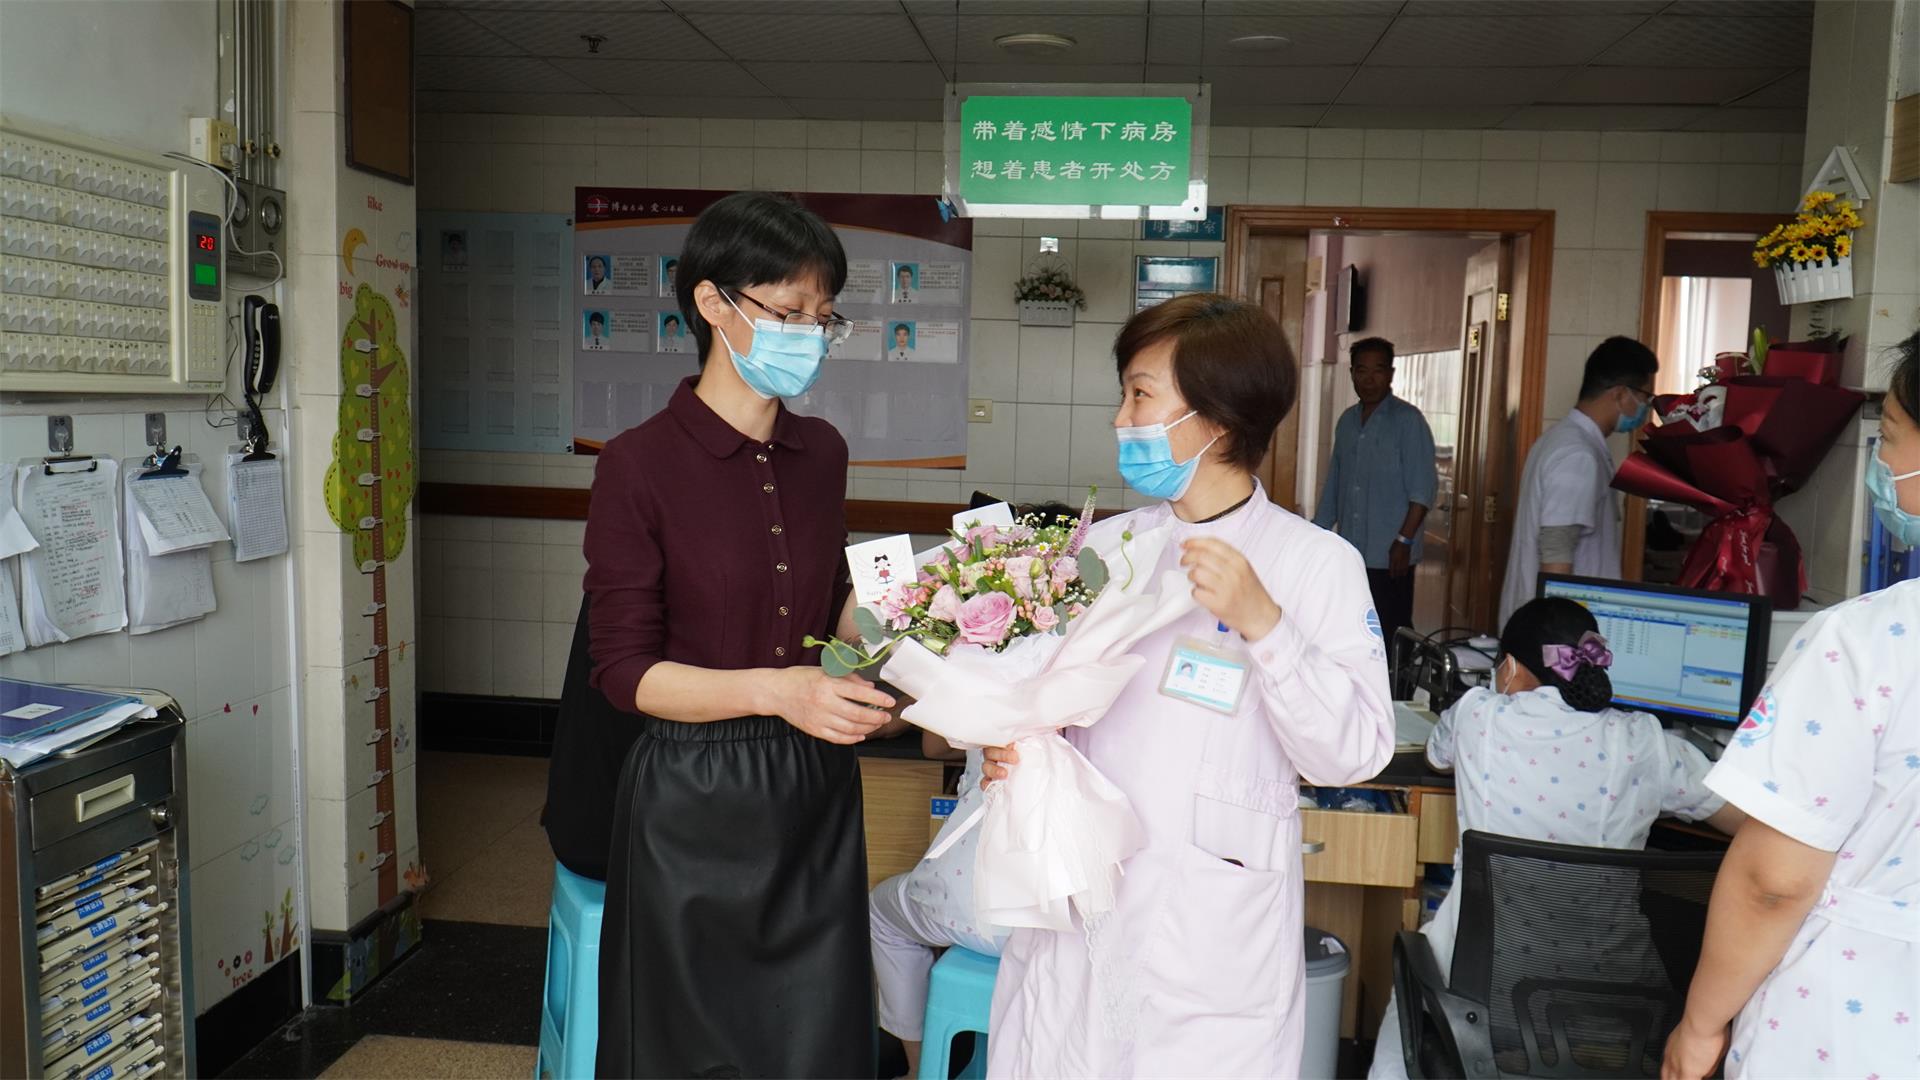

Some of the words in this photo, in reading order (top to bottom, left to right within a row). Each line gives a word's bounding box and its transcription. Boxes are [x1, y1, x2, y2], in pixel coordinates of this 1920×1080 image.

[972, 120, 1178, 142] 带着感情下病房
[970, 160, 1177, 181] 想着患者开处方
[367, 194, 383, 212] like
[200, 235, 215, 251] 20
[376, 253, 399, 270] Grow
[339, 281, 353, 299] big
[232, 968, 253, 989] tree
